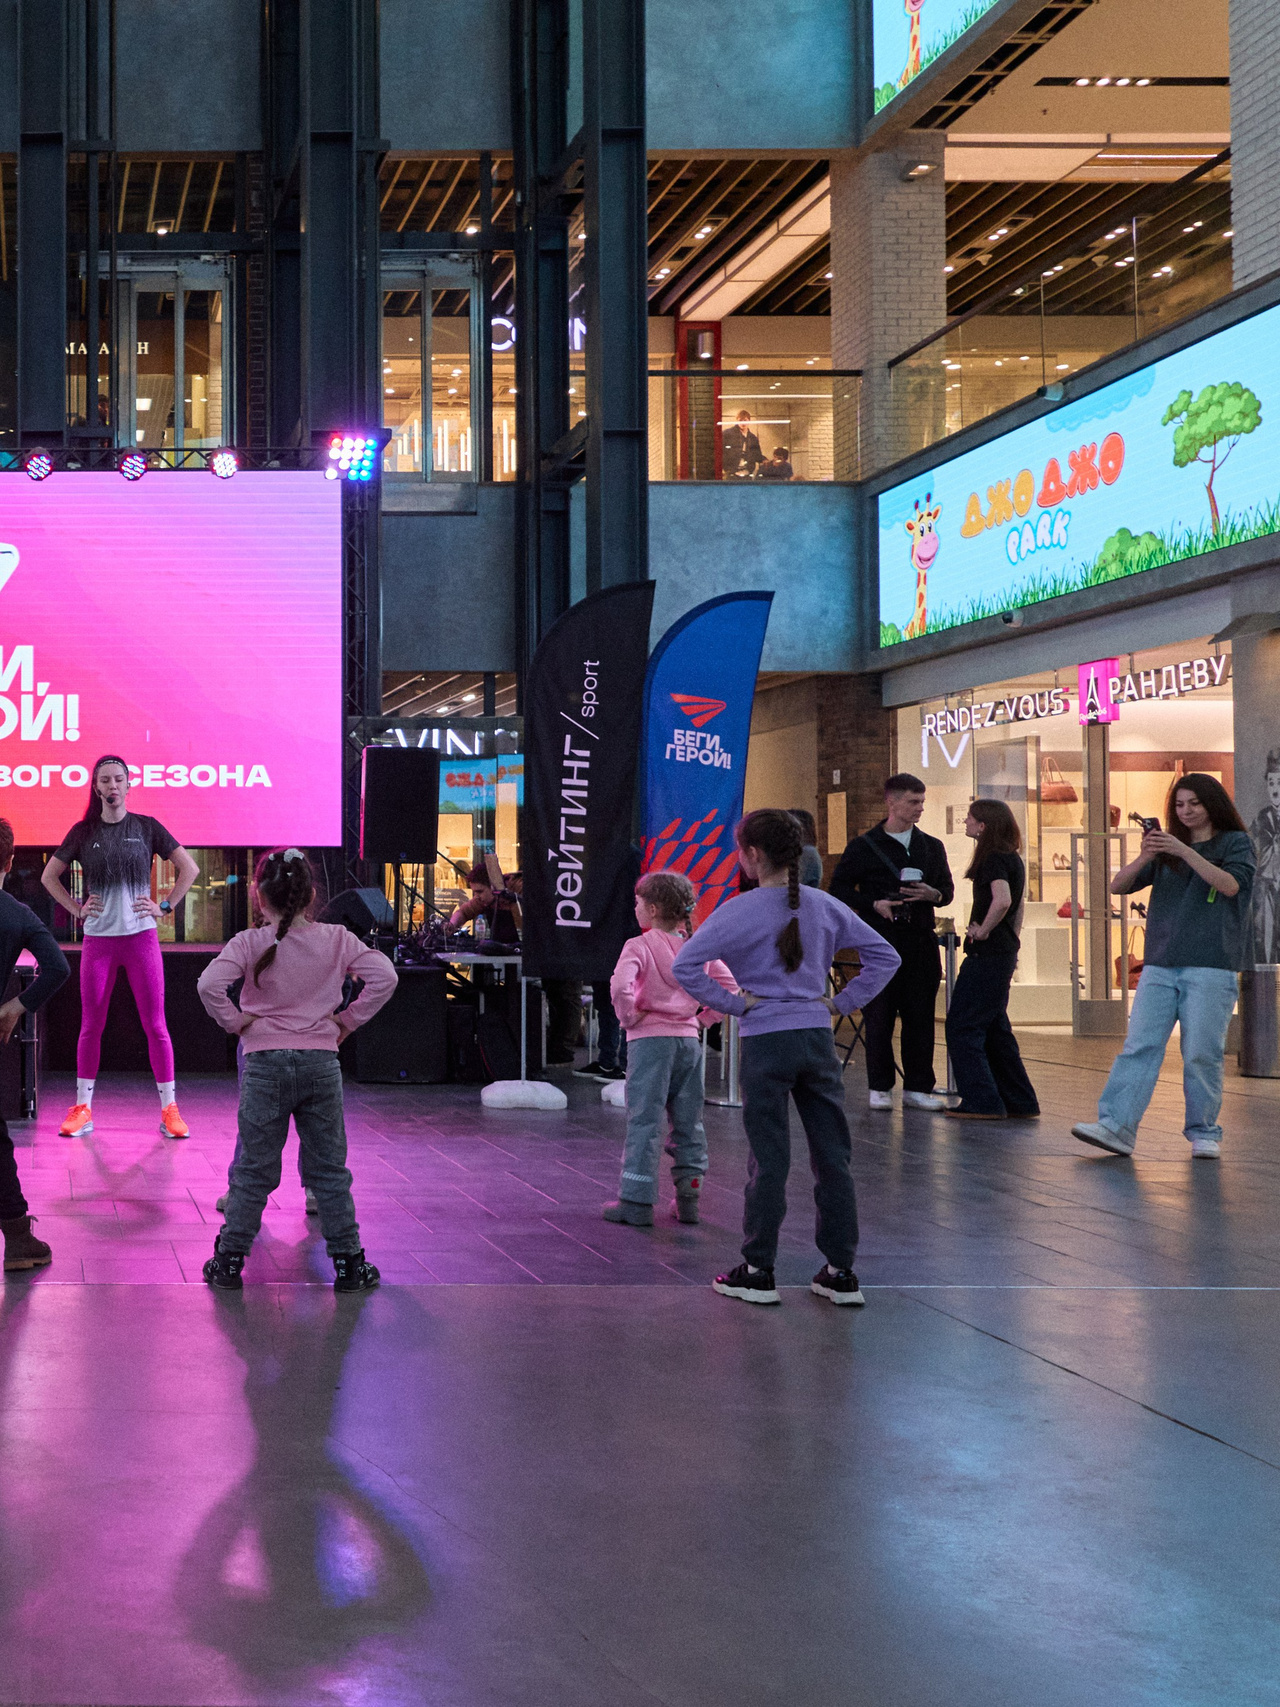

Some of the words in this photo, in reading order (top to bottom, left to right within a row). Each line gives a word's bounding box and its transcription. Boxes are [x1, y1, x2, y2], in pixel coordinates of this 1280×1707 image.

[960, 468, 1035, 538] ДЖО
[1036, 431, 1125, 508] ДЖО
[1006, 508, 1071, 565] PARK
[1108, 654, 1227, 704] РАНДЕВУ
[923, 687, 1066, 736] RENDEZ-VOUS
[665, 743, 731, 769] ГЕРОЙ!
[673, 728, 724, 753] БЕГИ,
